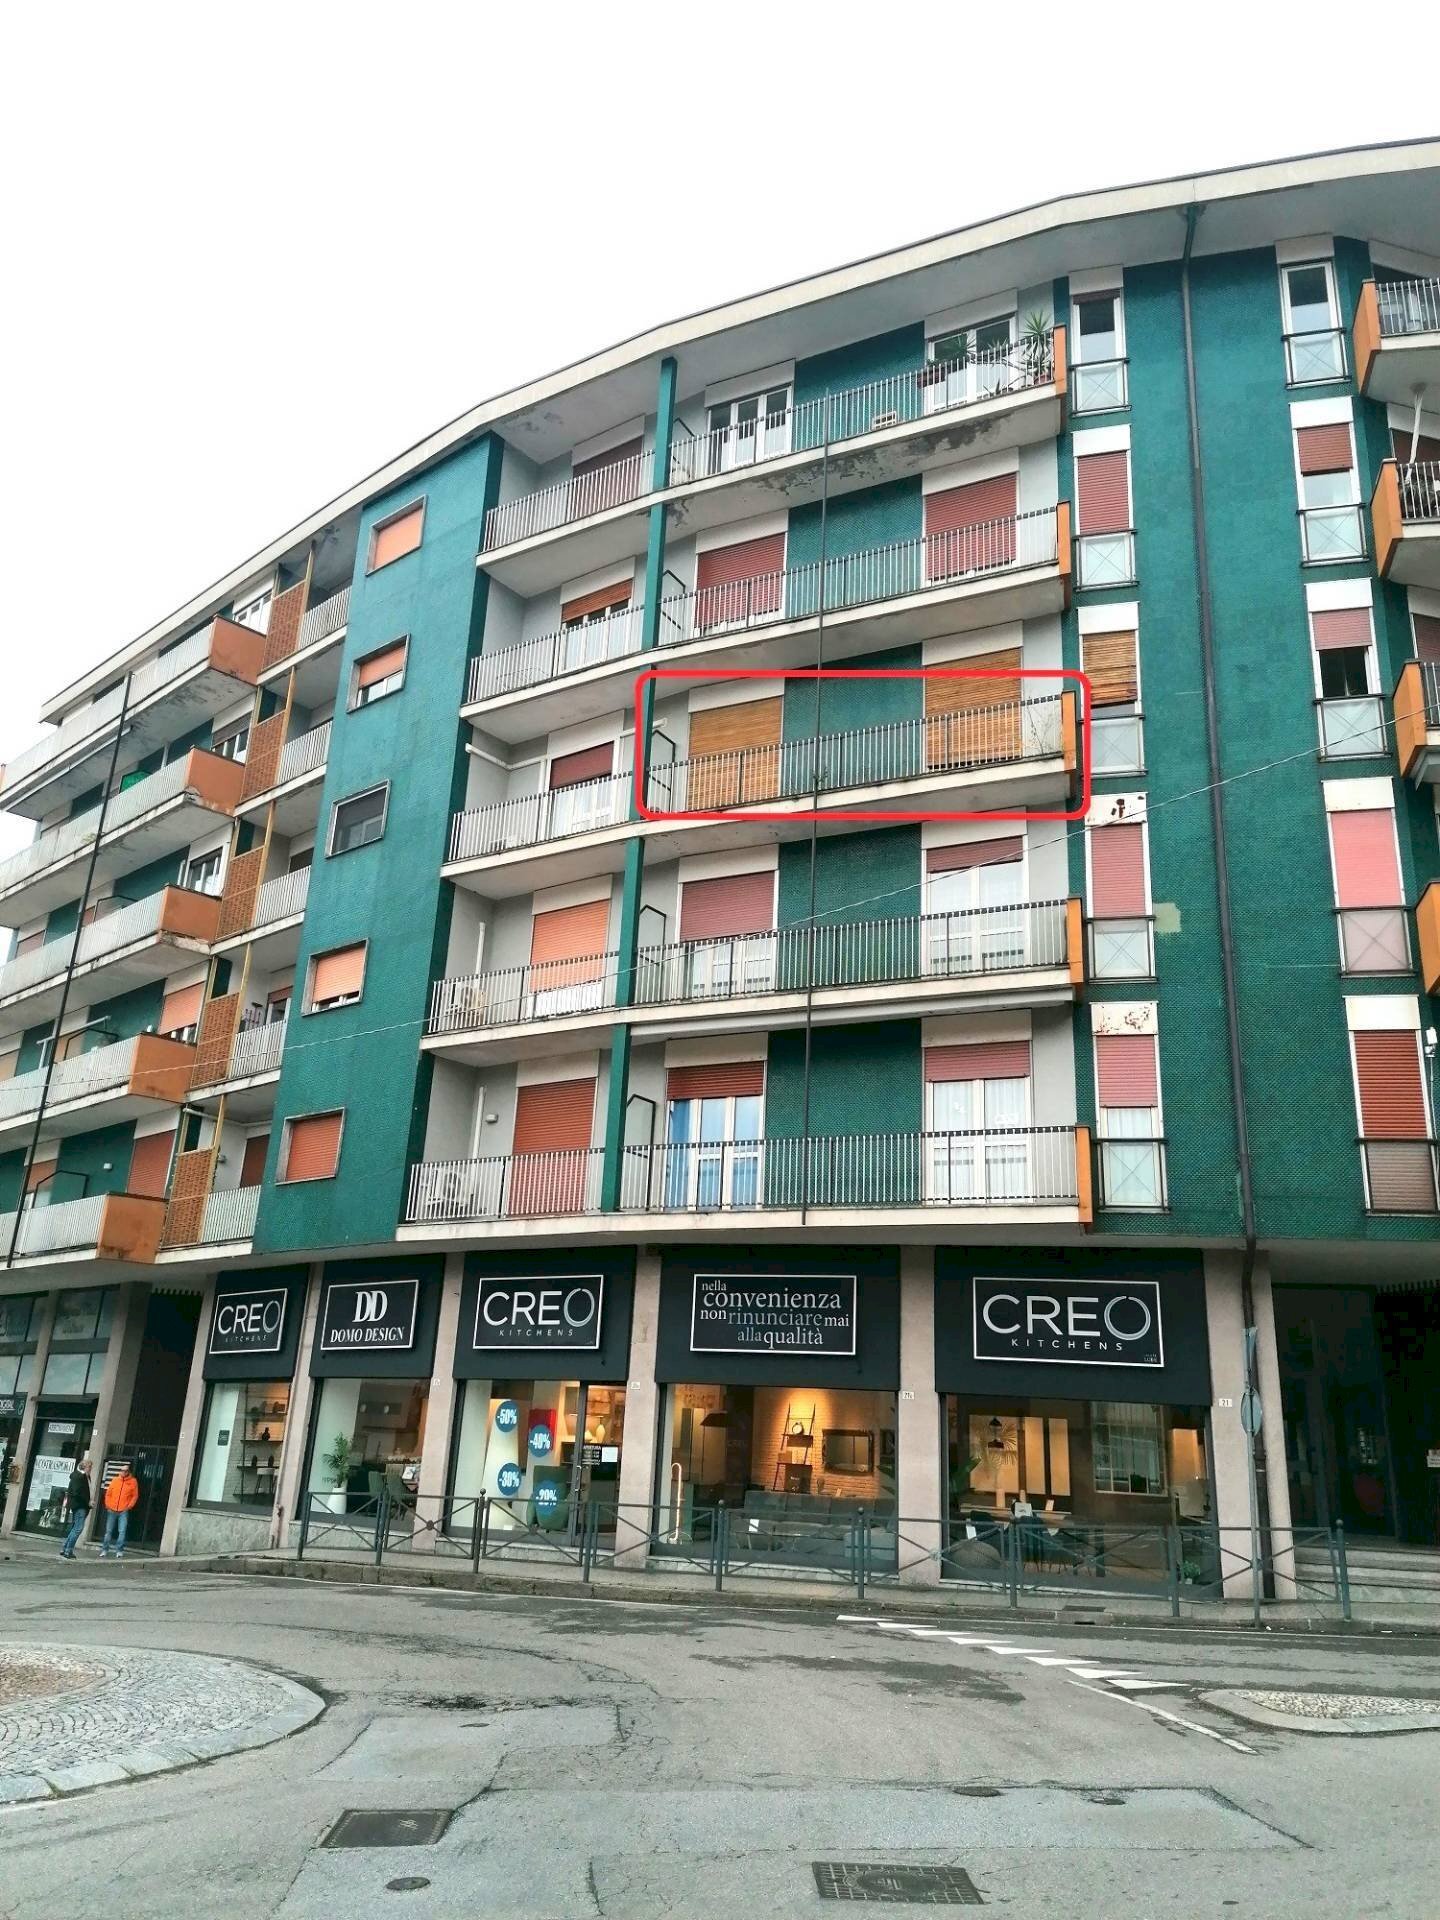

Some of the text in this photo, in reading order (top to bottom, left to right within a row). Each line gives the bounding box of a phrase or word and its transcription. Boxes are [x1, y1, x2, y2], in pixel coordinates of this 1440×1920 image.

[701, 1280, 727, 1291] nella
[351, 1290, 388, 1323] DD
[483, 1287, 595, 1327] CREO
[703, 1287, 842, 1309] convenienza
[218, 1300, 281, 1334] CREO
[700, 1308, 850, 1327] non rinunciare mai
[982, 1294, 1151, 1341] CREO
[330, 1326, 405, 1343] DOMO DESIGN
[499, 1328, 573, 1337] KITCHENS
[737, 1326, 824, 1350] alla qualità
[1011, 1337, 1124, 1352] KITCHENS
[497, 1408, 518, 1425] -50%
[529, 1432, 551, 1450] -40%
[498, 1470, 520, 1488] -30%
